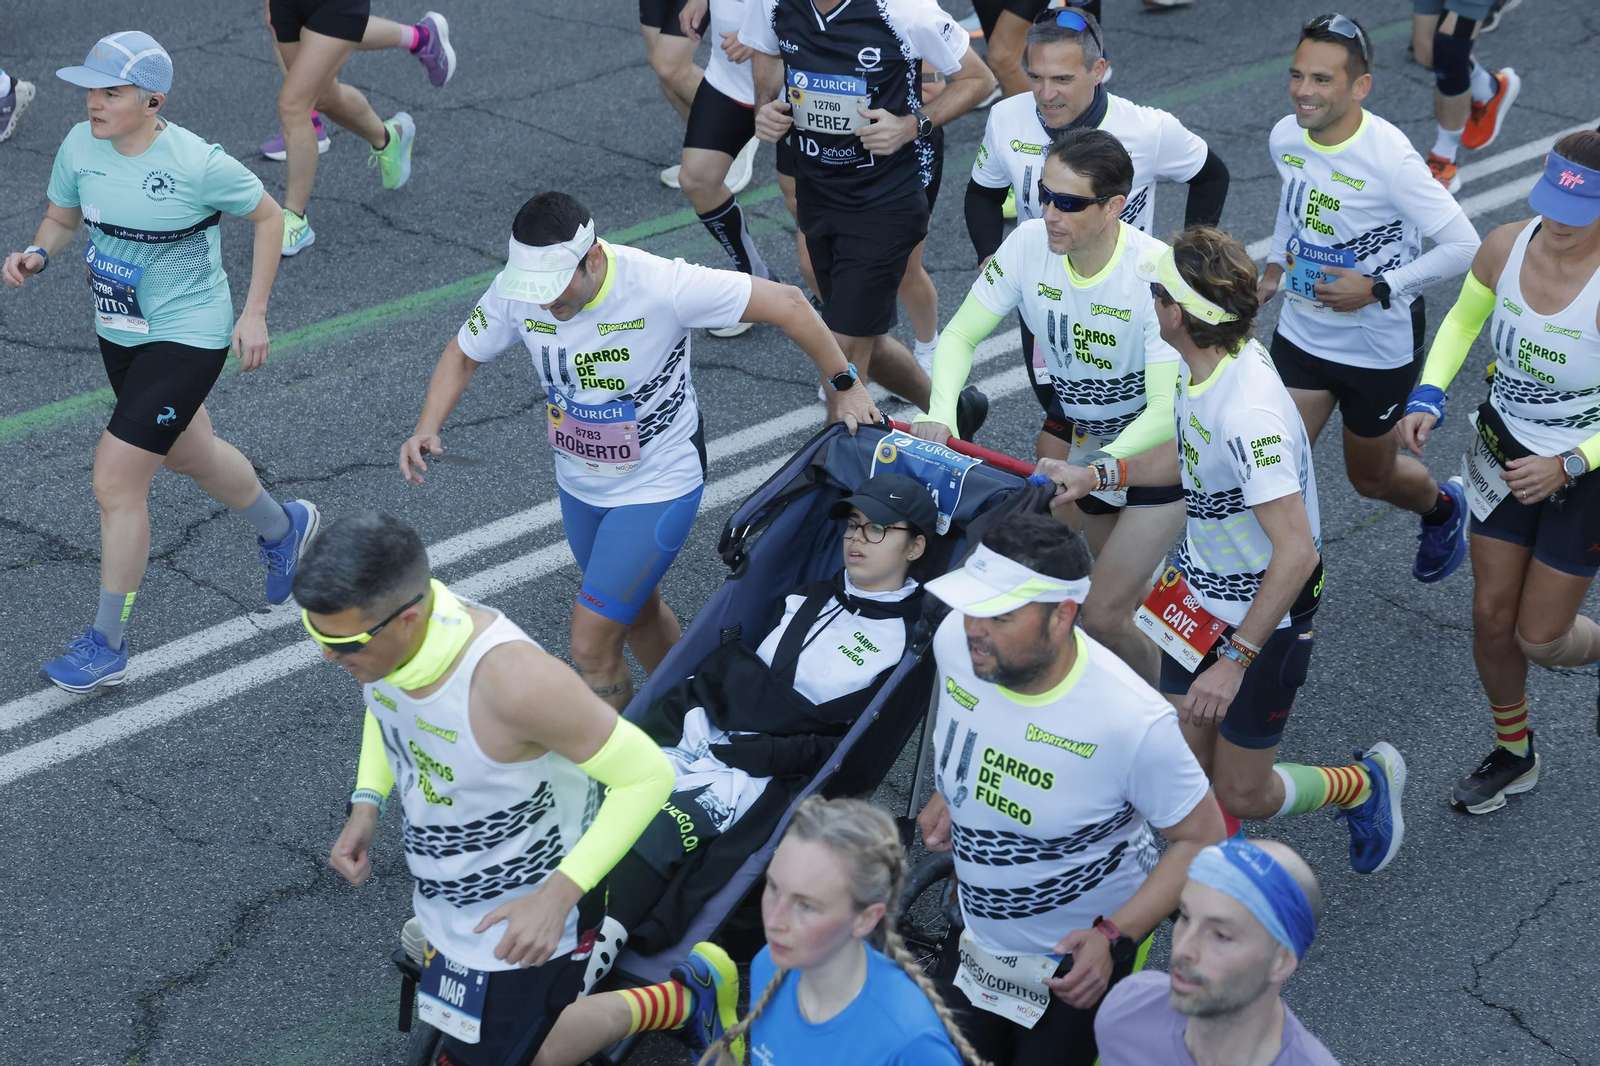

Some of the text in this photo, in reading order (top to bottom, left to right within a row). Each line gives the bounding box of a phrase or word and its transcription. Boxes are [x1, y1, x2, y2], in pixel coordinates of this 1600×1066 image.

[812, 78, 856, 92] ZURICH
[813, 99, 841, 113] 12760
[807, 112, 852, 131] PEREZ
[822, 146, 857, 157] school
[1306, 202, 1321, 218] DE
[1302, 247, 1344, 265] ZURICH
[1073, 337, 1090, 351] DE
[1519, 337, 1568, 366] CARROS
[573, 347, 631, 367] CARROS
[1518, 348, 1533, 365] DE
[575, 364, 597, 378] DE
[1518, 359, 1557, 385] FUEGO
[579, 378, 626, 392] FUEGO
[571, 405, 623, 420] ZURICH
[575, 426, 602, 441] 8783
[1250, 434, 1283, 449] CARROS
[554, 430, 631, 460] ROBERTO
[916, 441, 964, 463] ZURICH
[1252, 447, 1265, 460] DE
[1255, 454, 1282, 469] FUEGO
[1162, 603, 1199, 640] CAYE
[853, 631, 881, 654] CARROS
[837, 644, 865, 667] FUEGO
[983, 746, 1055, 791] CARROS
[977, 766, 1003, 790] DE
[974, 784, 1033, 827] FUEGO
[438, 974, 467, 1008] MAR
